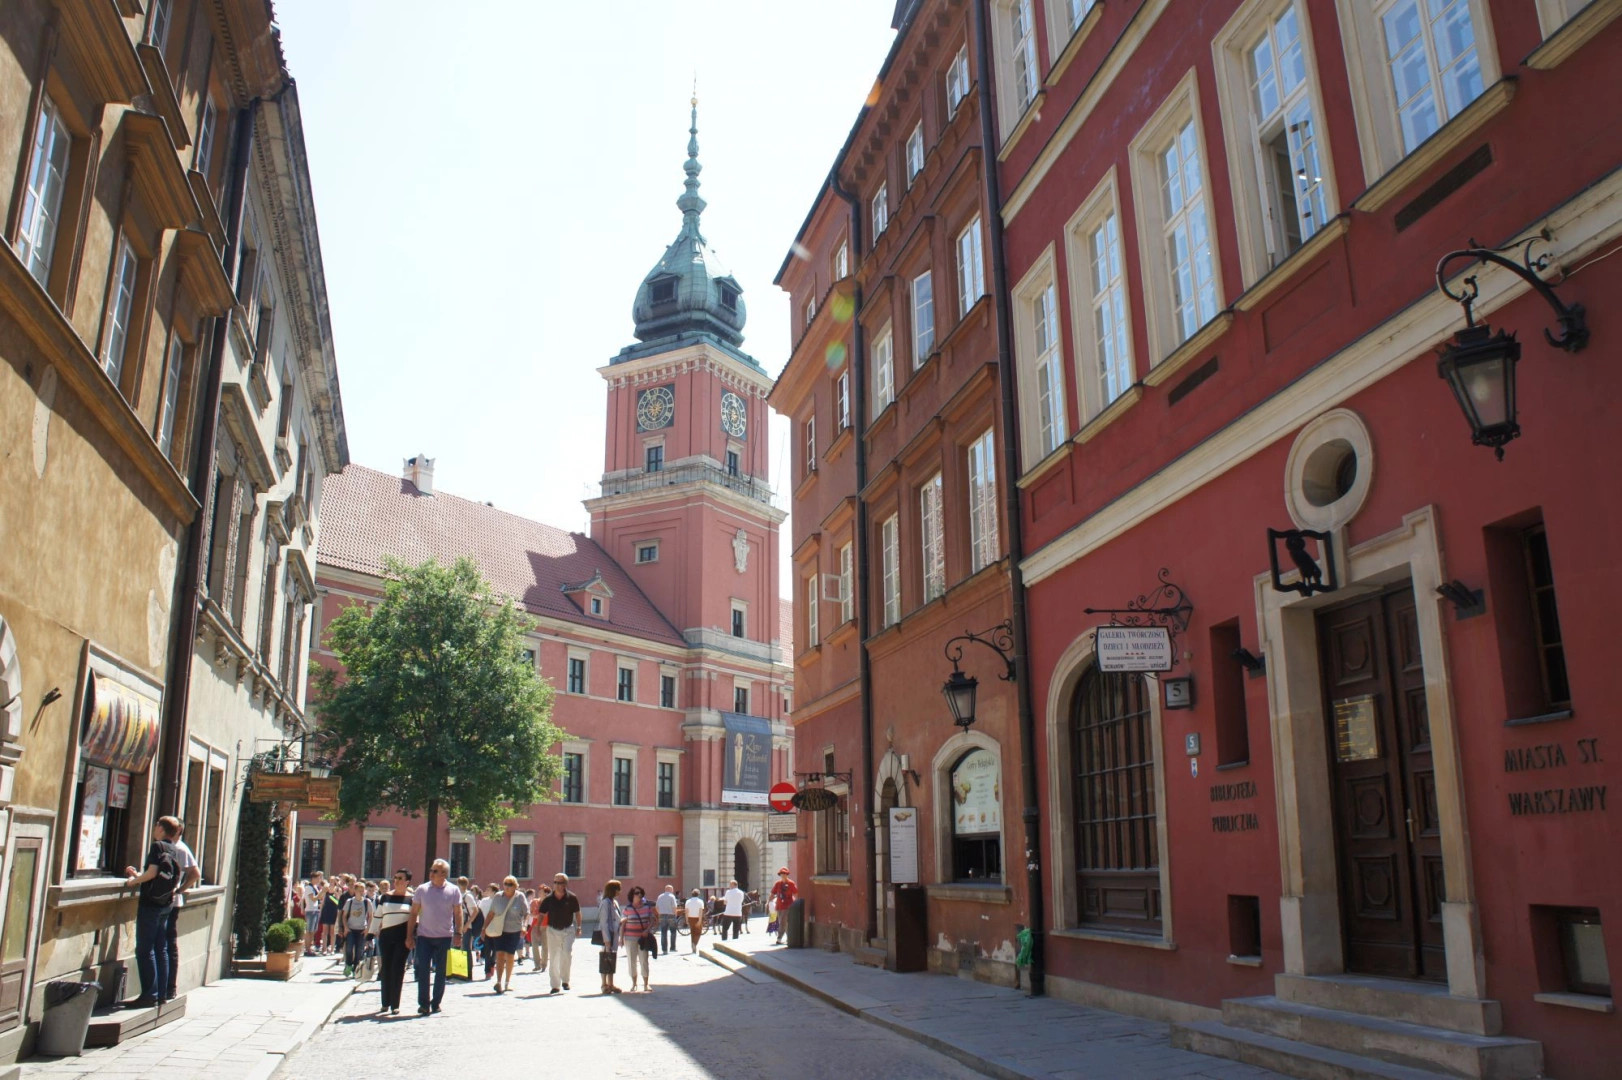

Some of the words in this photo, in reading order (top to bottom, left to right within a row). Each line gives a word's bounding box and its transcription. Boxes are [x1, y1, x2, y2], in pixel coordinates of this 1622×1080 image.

[1128, 629, 1165, 638] TWÓRCZOŚCI
[1103, 642, 1123, 650] DZIECI
[1131, 641, 1165, 650] MŁODZIEŻY
[1172, 683, 1182, 697] 5
[1189, 735, 1195, 748] 5
[1504, 744, 1567, 772] MIASTA
[1577, 738, 1604, 764] ST.
[1210, 780, 1258, 802] BIBLIOTEKA
[1508, 786, 1607, 816] WARSZAWY
[1212, 813, 1259, 832] PUBLICZNA
